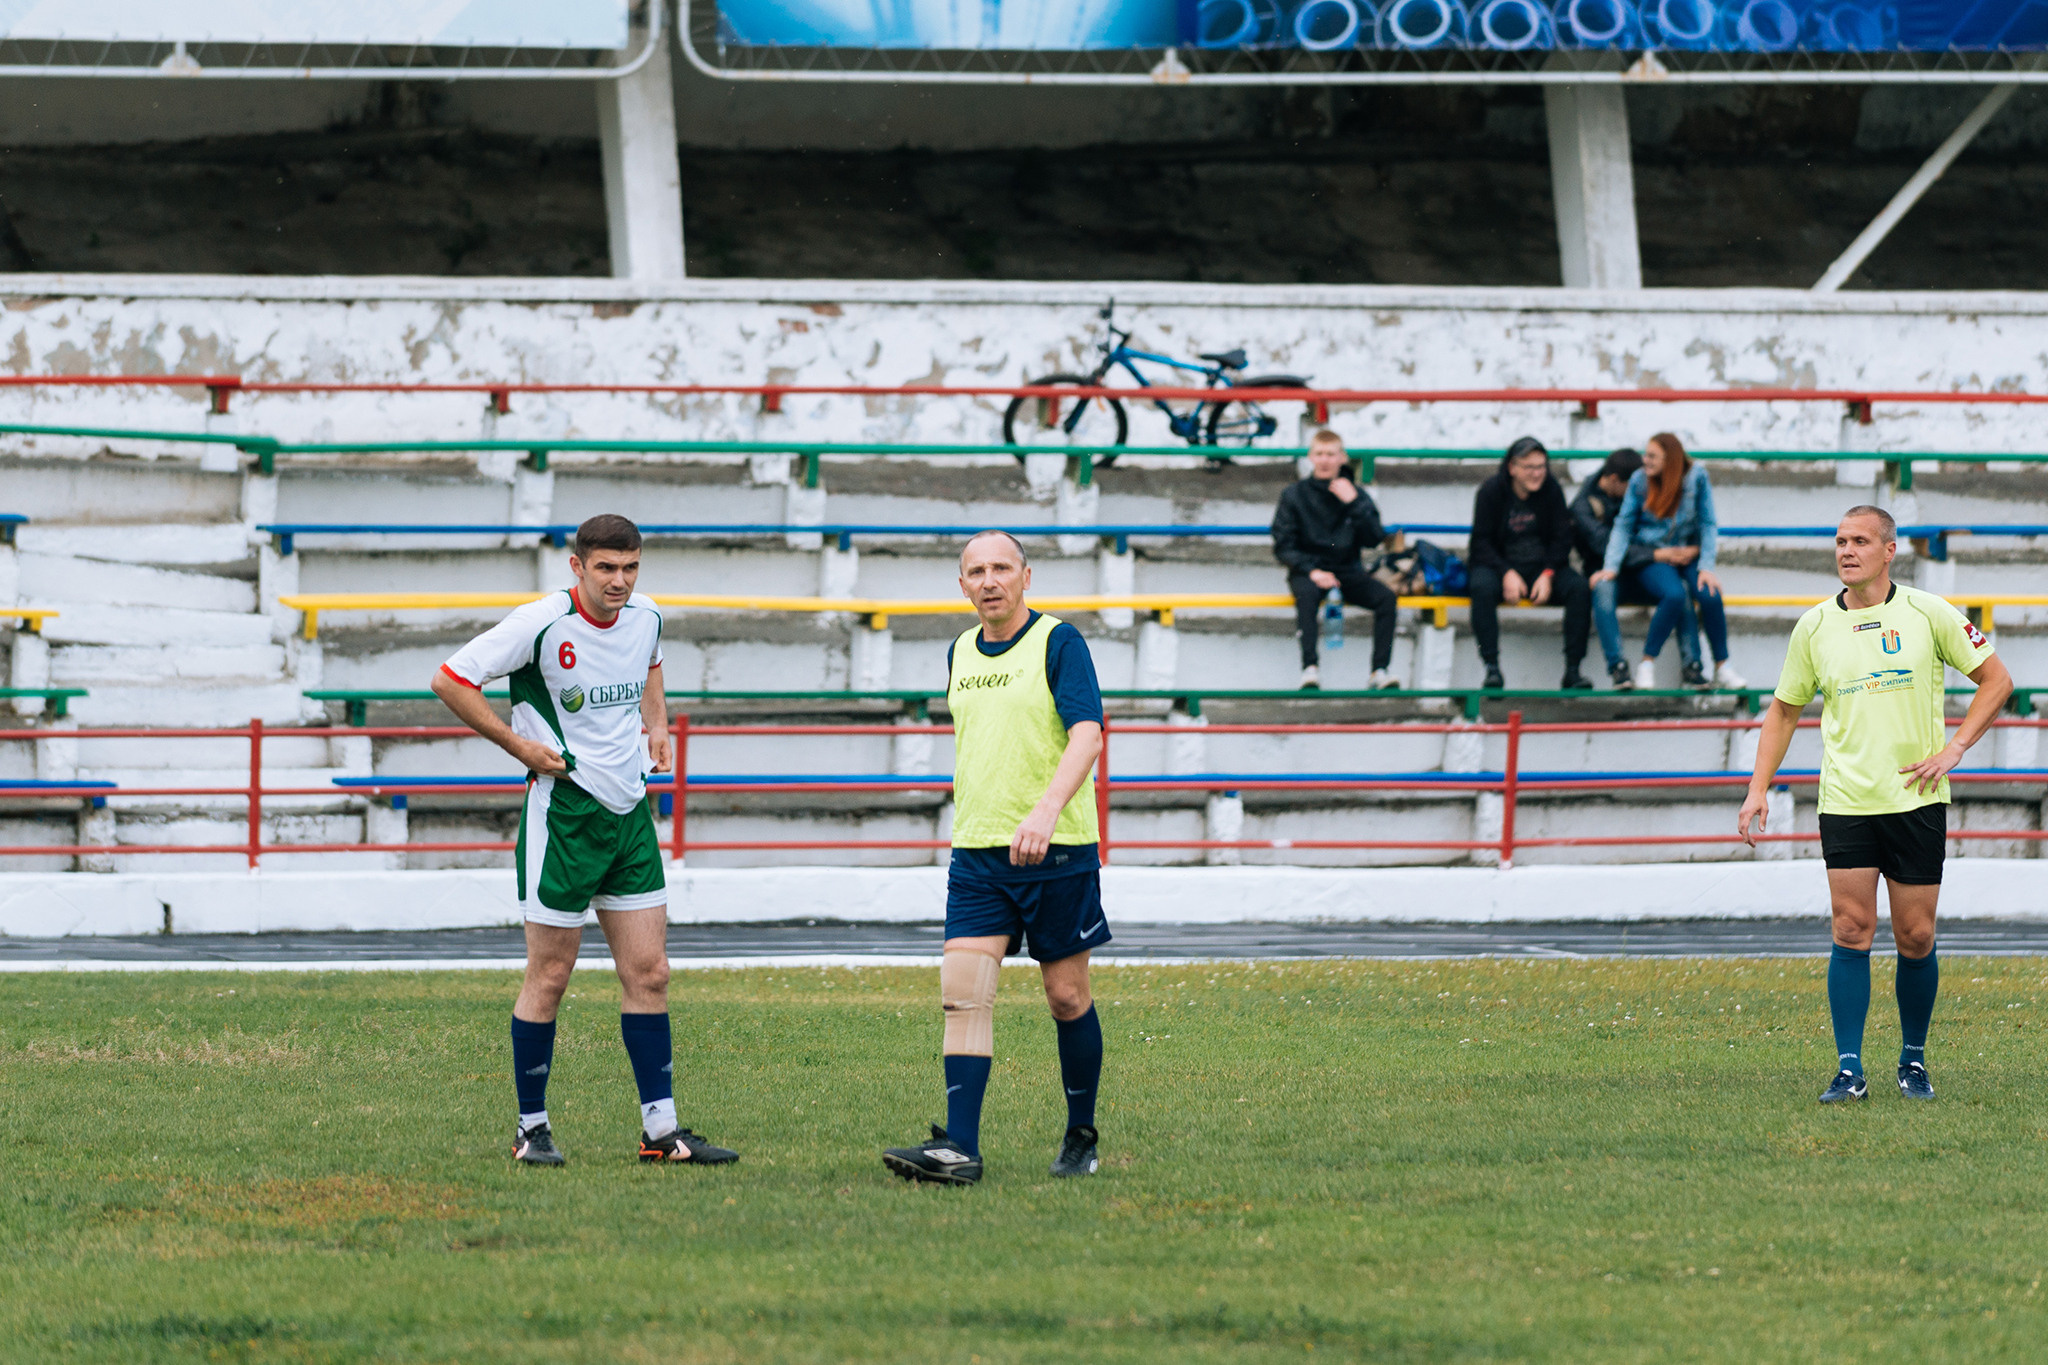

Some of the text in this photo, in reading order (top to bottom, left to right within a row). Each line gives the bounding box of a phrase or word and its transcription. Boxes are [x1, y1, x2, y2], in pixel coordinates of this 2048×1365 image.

[559, 641, 576, 669] 6
[957, 673, 1014, 691] seven
[1865, 681, 1880, 690] VIP
[589, 681, 646, 705] СБЕРБАН
